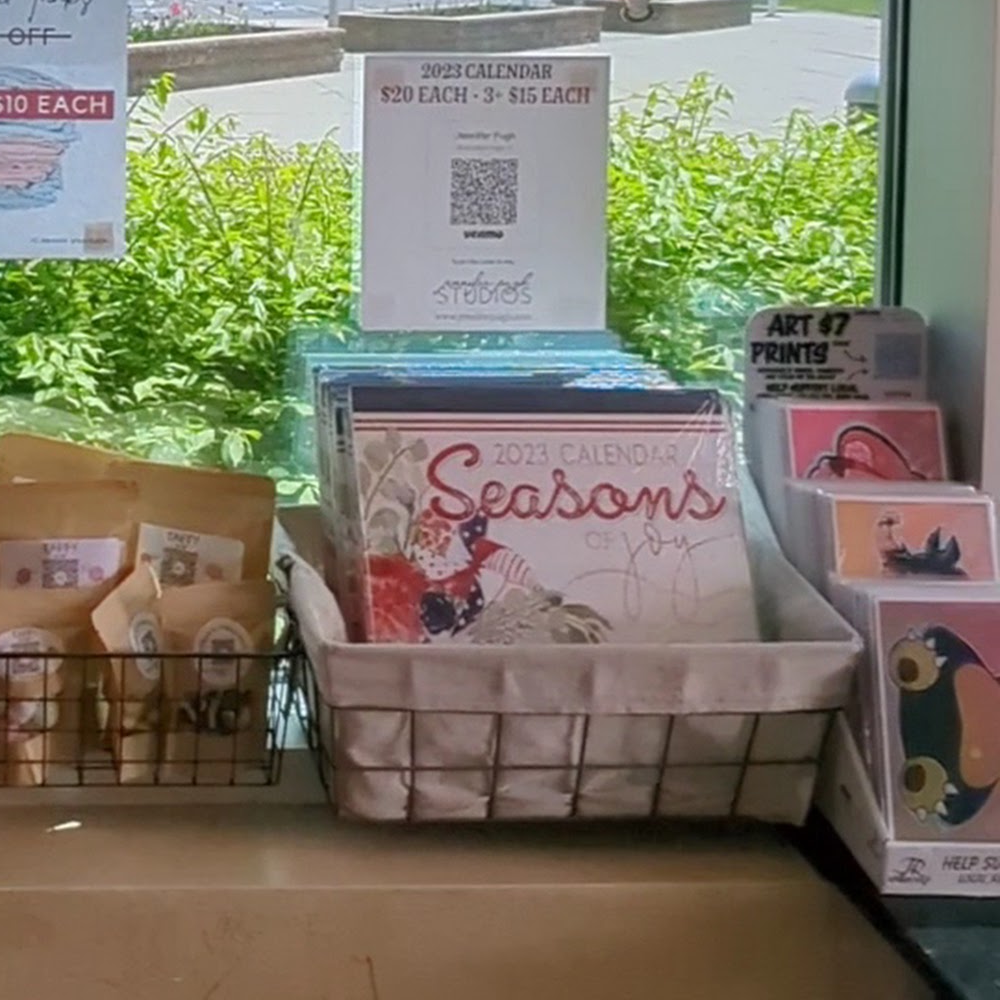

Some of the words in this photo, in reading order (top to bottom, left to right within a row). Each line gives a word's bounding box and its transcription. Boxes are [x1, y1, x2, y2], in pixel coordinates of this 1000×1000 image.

[8, 27, 56, 45] OFF
[421, 63, 462, 79] 2023
[465, 63, 553, 79] CALENDAR
[37, 95, 107, 115] EACH
[381, 86, 414, 104] $20
[418, 86, 468, 104] EACH
[508, 86, 537, 104] $15
[541, 86, 591, 104] EACH
[767, 313, 814, 337] ART
[819, 311, 851, 337] $7
[751, 341, 829, 364] PRINTS
[495, 443, 549, 465] 2023
[562, 443, 678, 466] CALENDAR
[427, 443, 727, 521] Seasons
[942, 855, 979, 871] HELP
